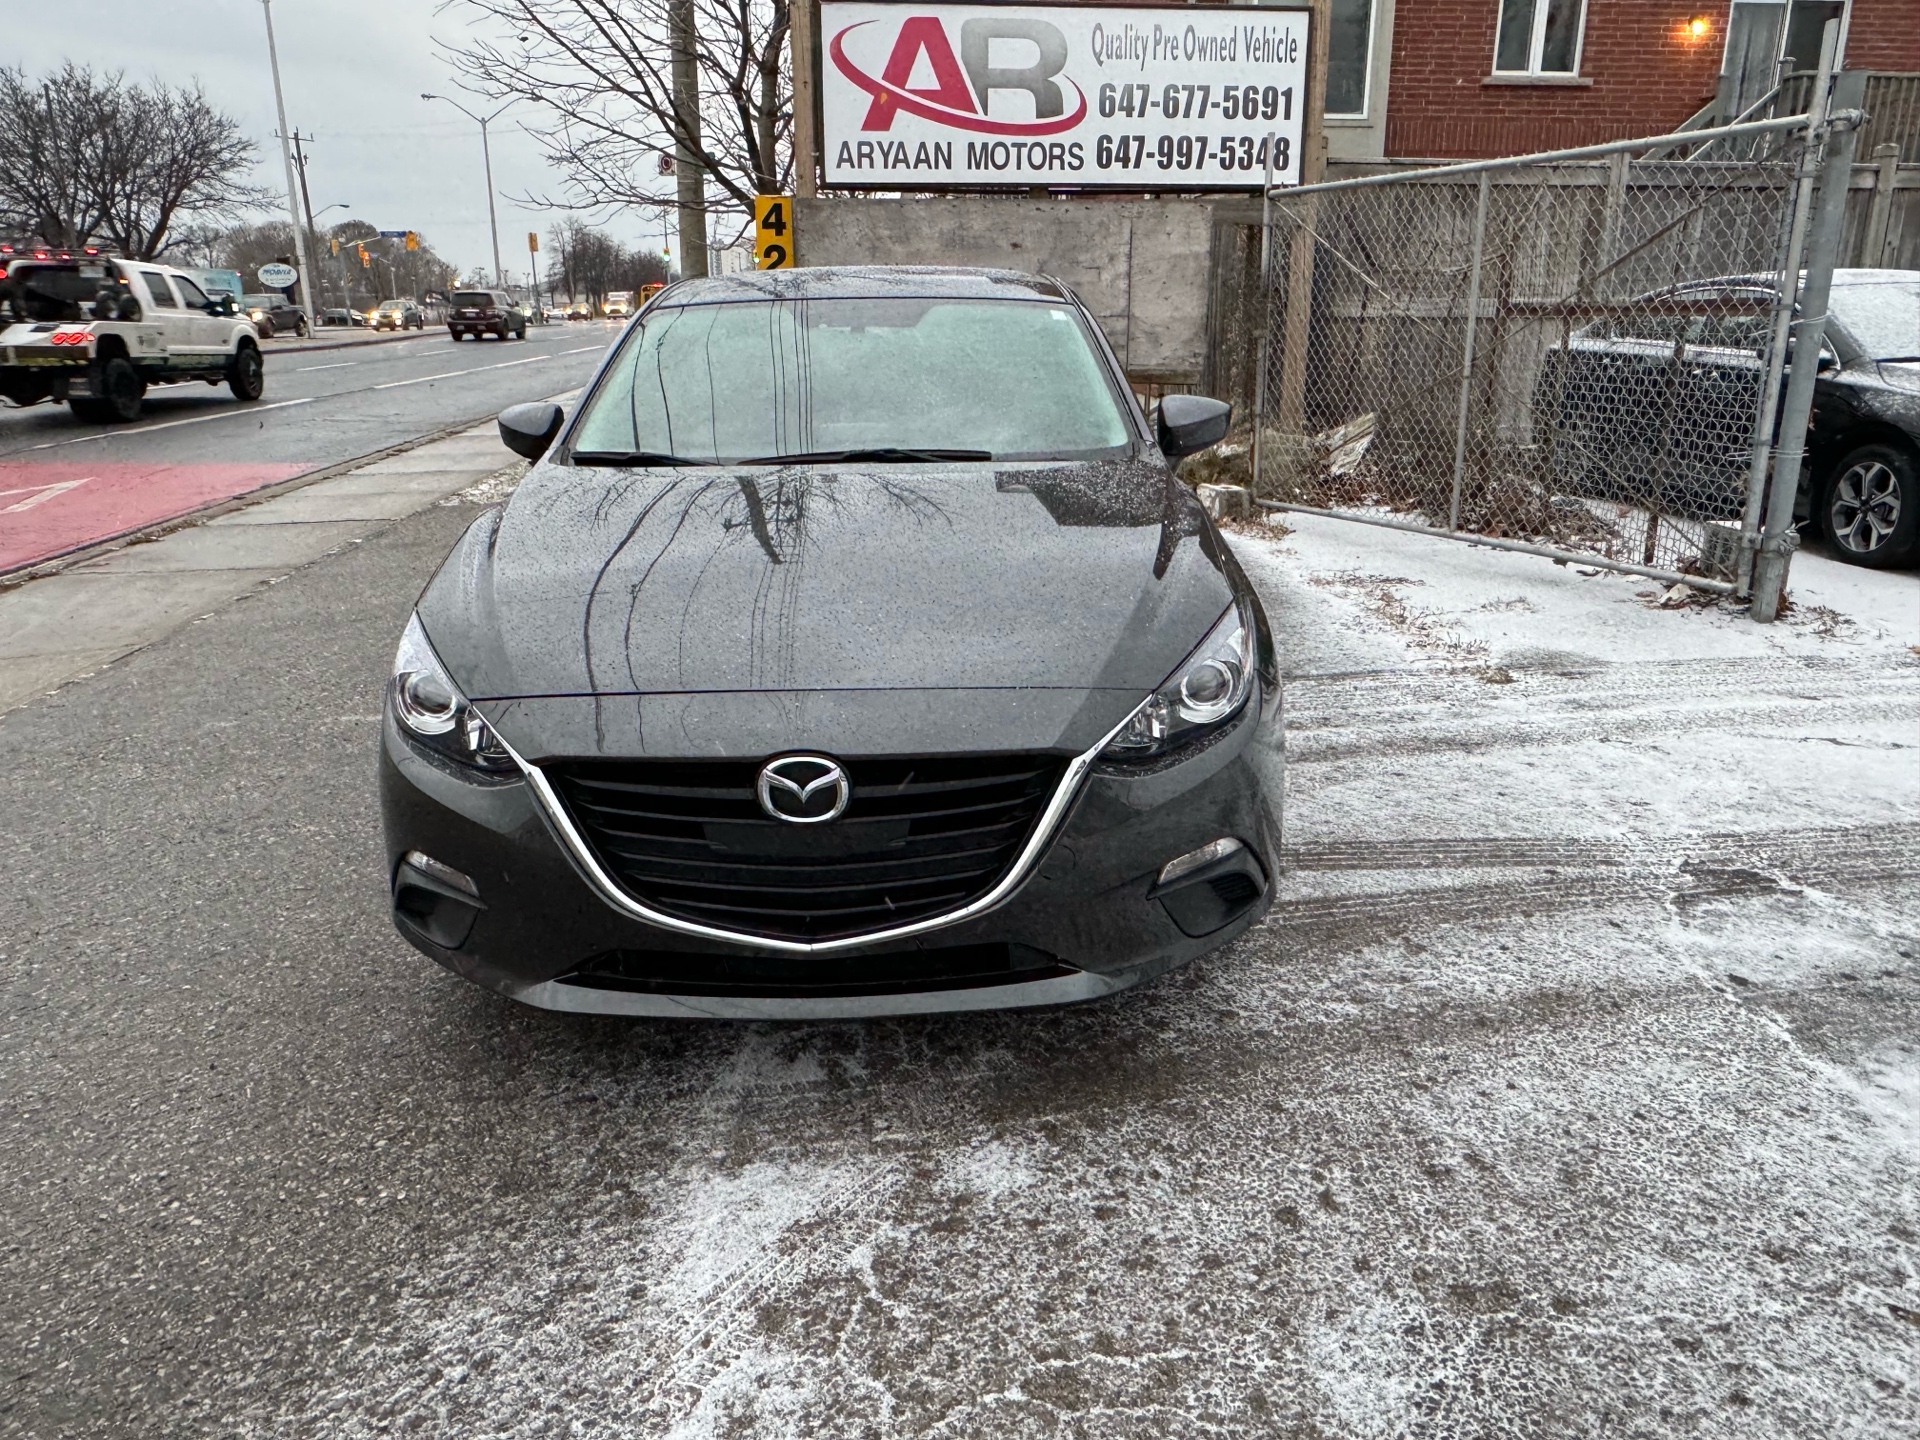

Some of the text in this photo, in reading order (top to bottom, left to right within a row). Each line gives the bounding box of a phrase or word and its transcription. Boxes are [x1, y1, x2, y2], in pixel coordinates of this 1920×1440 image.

[1091, 22, 1298, 71] Quality Pre Owned Vehicle
[861, 16, 1068, 131] AR
[1099, 82, 1293, 121] 647-677-5691
[836, 140, 1085, 171] ARYAAN MOTORS
[1096, 134, 1290, 171] 647-997-5348
